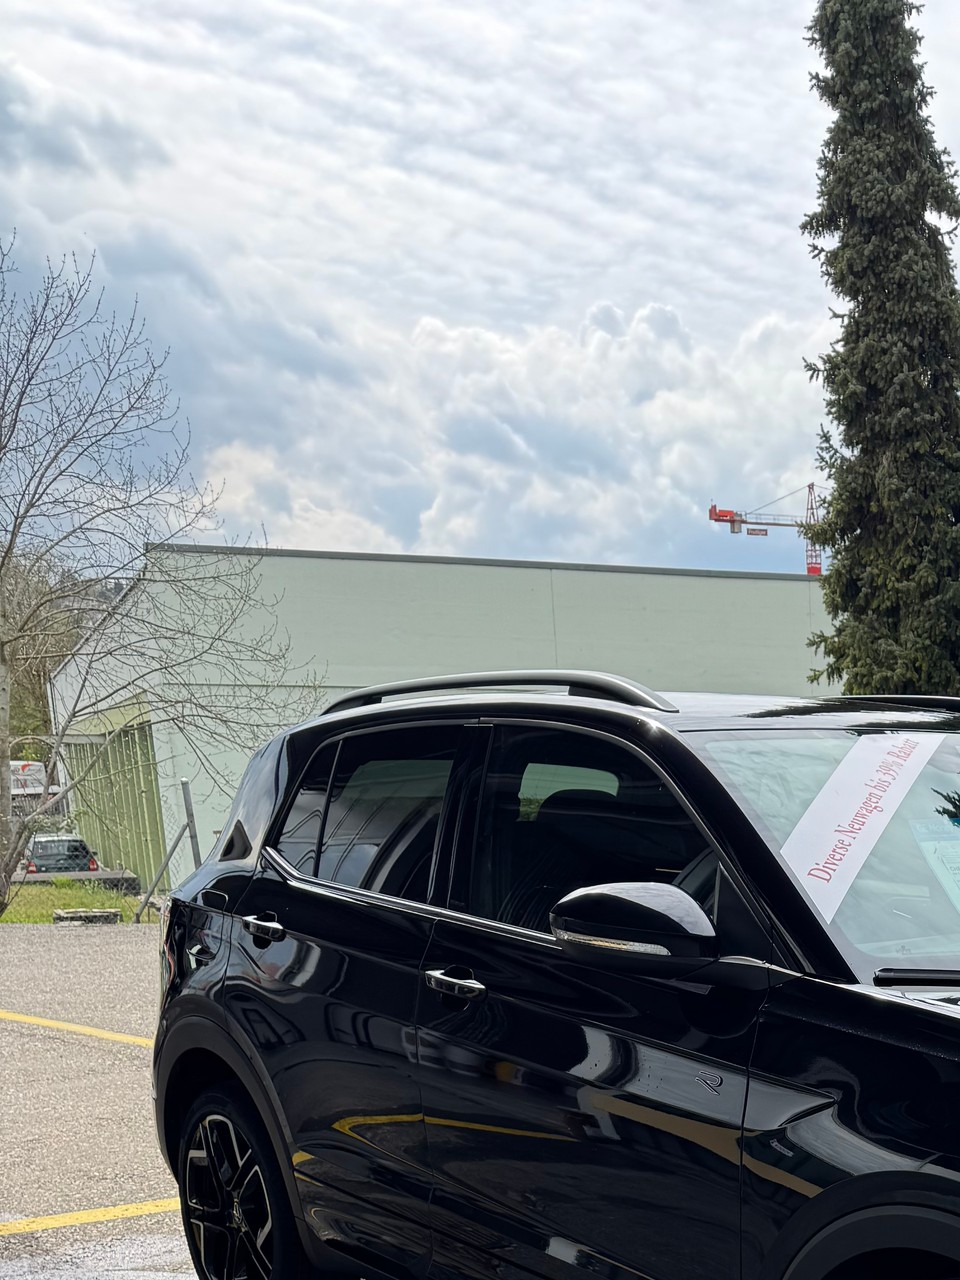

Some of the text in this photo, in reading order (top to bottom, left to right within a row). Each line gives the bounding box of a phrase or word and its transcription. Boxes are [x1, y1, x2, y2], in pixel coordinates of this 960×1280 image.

[807, 738, 920, 883] Diverse Neuwagen bis 39% Rabatt
